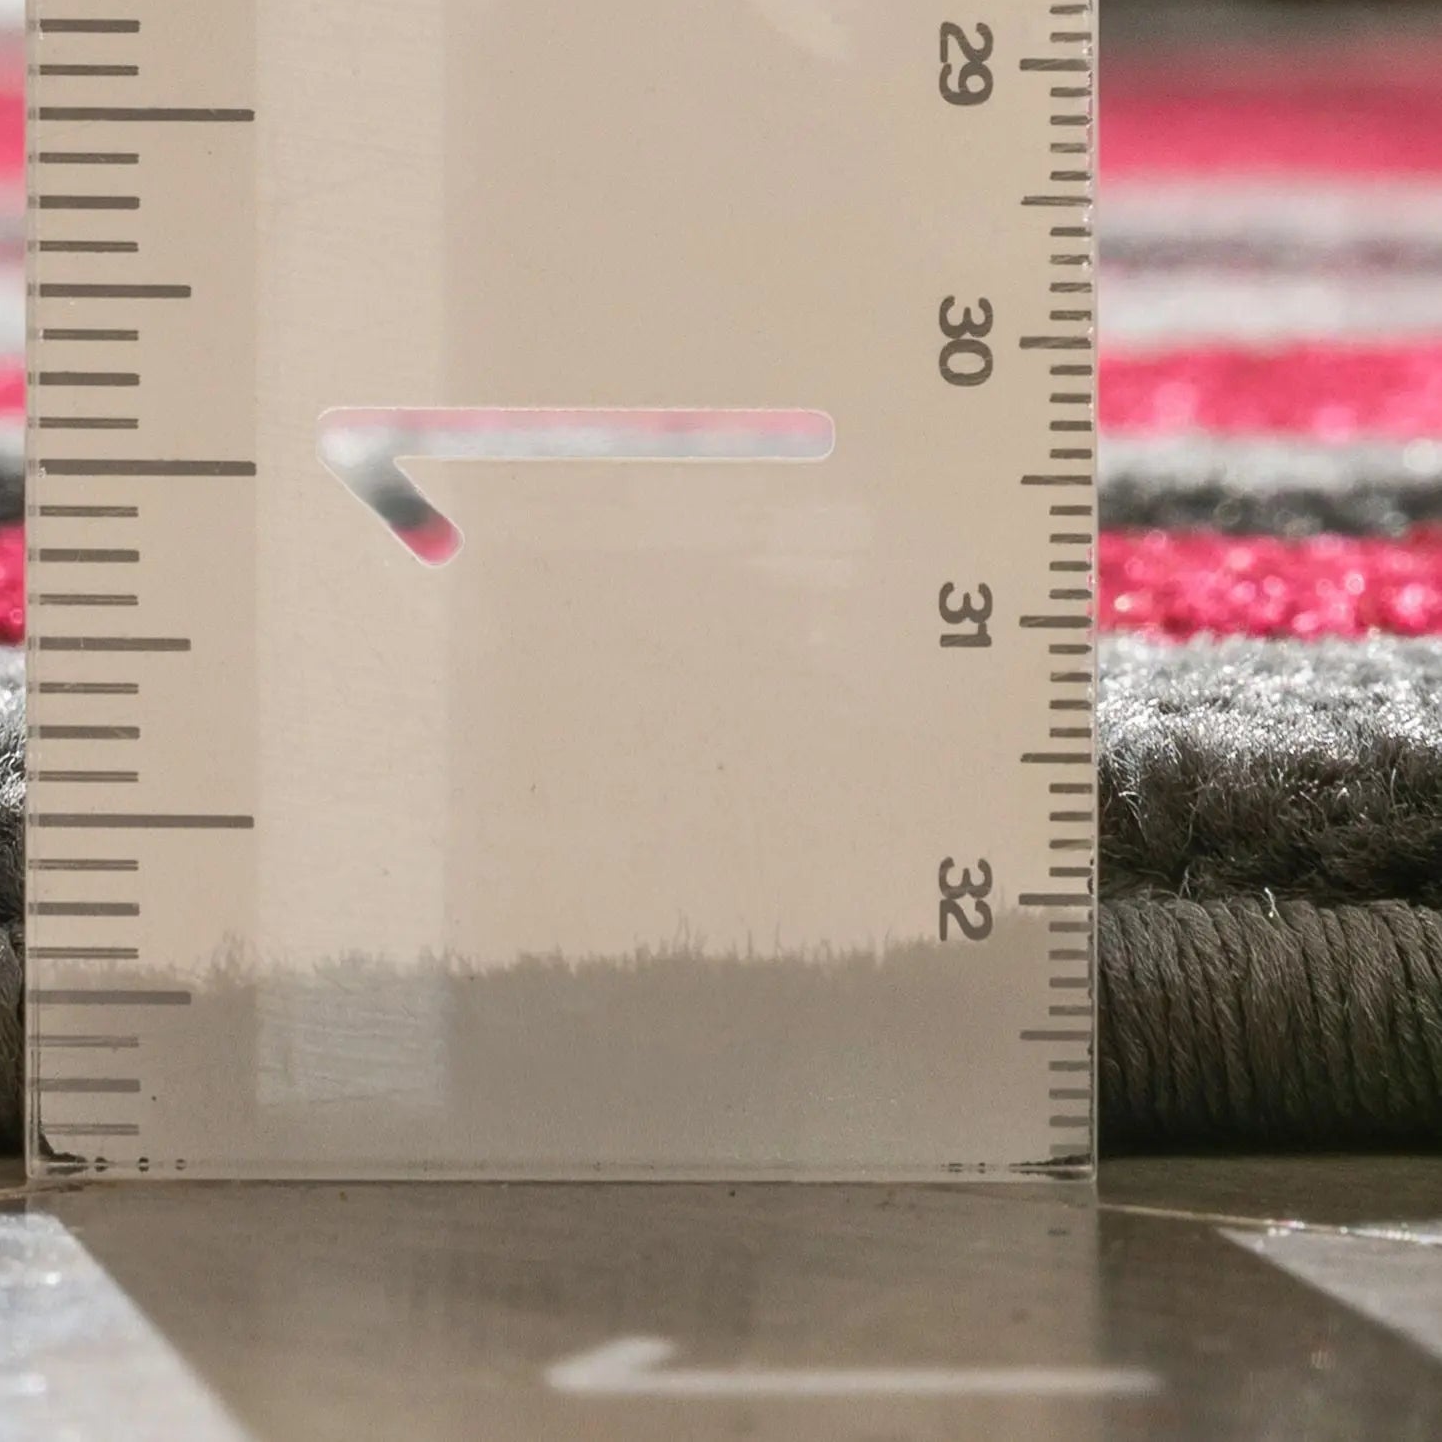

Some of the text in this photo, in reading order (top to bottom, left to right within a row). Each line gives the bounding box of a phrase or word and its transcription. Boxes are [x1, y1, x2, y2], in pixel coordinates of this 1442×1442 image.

[938, 21, 994, 107] 29
[938, 295, 994, 387] 30
[316, 406, 836, 567] 1
[938, 580, 994, 649] 31
[938, 856, 994, 943] 32
